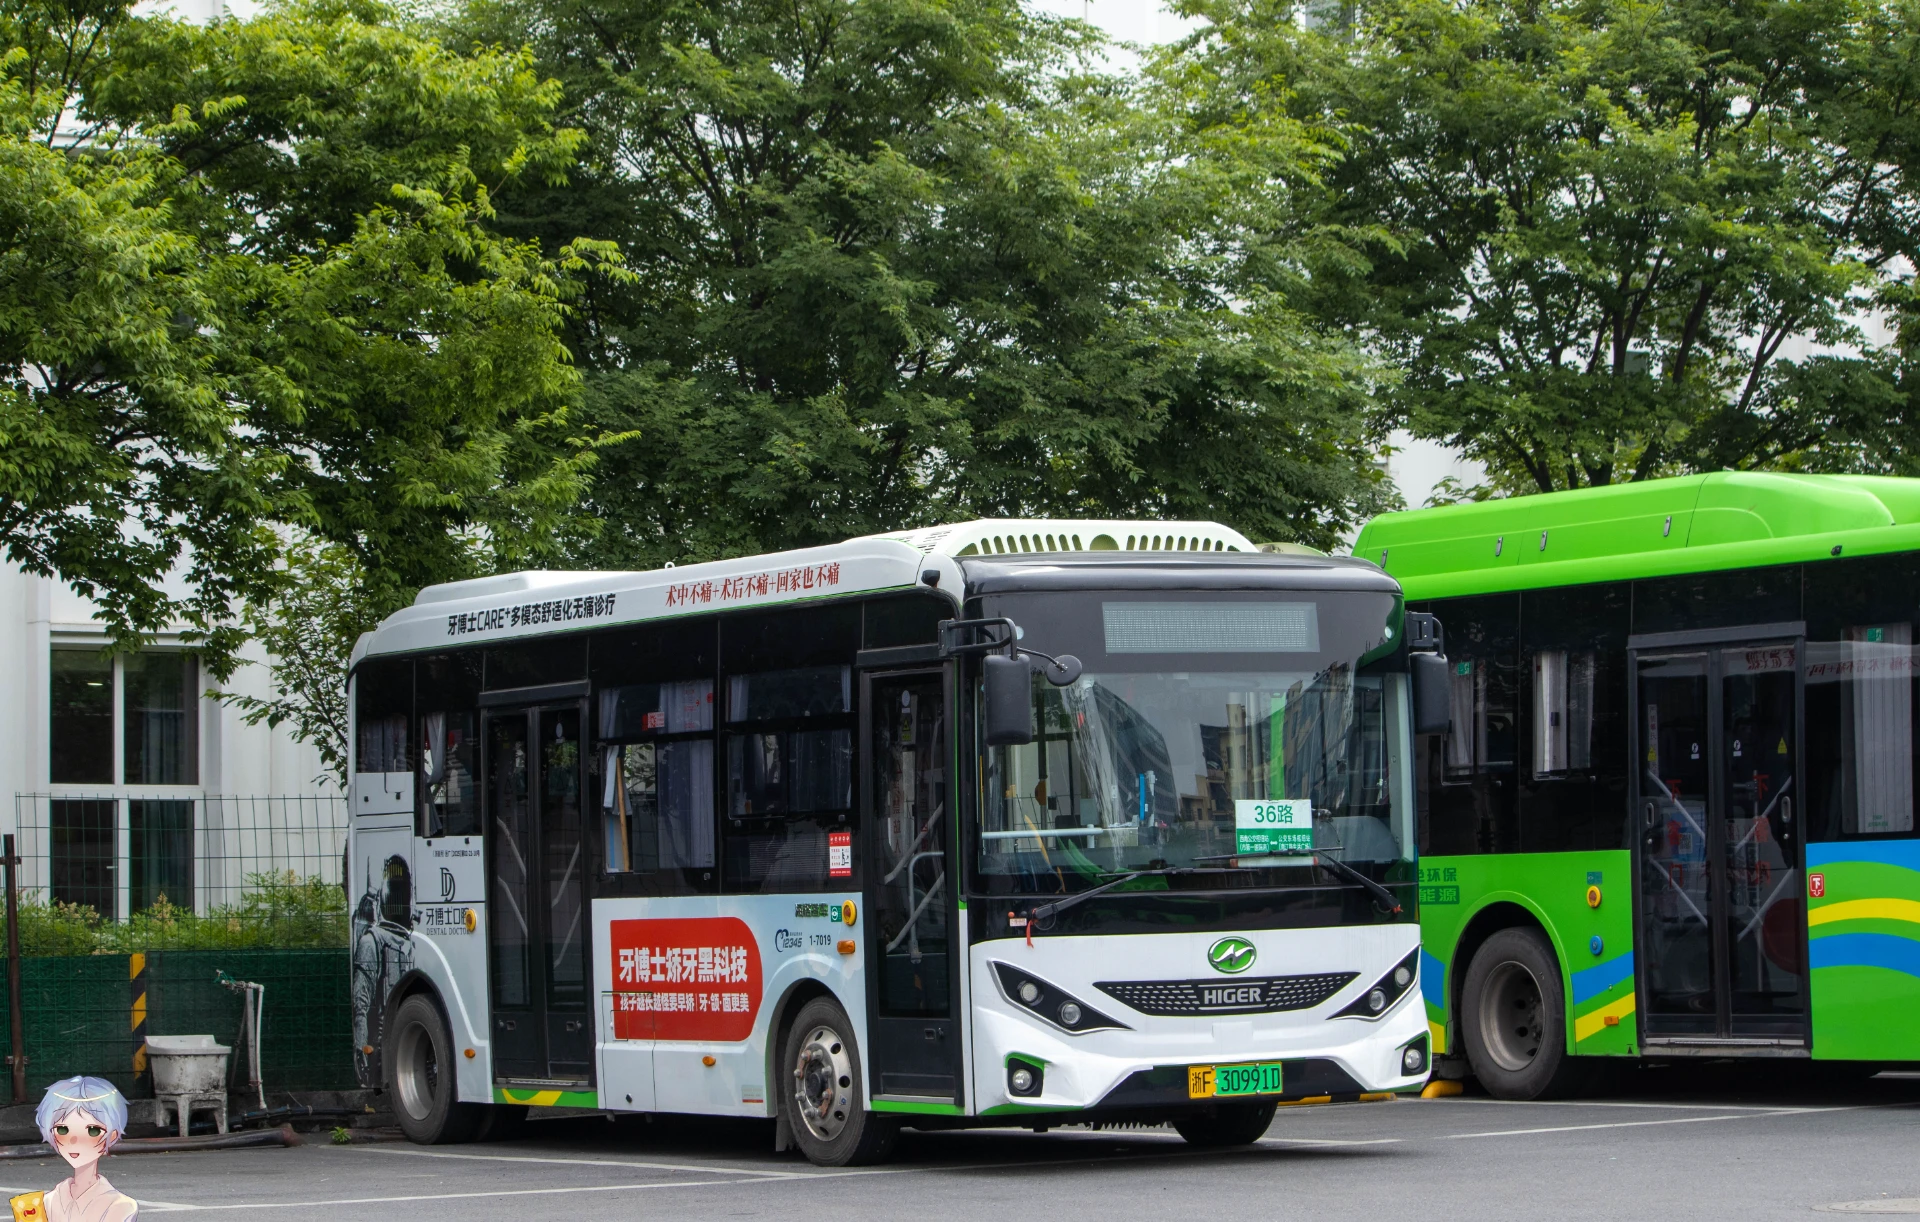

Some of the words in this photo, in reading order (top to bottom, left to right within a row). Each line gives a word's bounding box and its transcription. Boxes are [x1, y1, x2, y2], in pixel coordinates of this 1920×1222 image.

[665, 562, 840, 607] 术中不痛+术后不痛+回家也不痛
[1254, 804, 1293, 824] 36路
[1812, 877, 1821, 890] 下
[426, 927, 447, 936] DENTAL
[809, 934, 832, 946] 1-7019
[782, 937, 803, 948] 12345
[618, 945, 748, 983] 牙博士矫牙黑科技
[1204, 987, 1262, 1005] HIGER
[1220, 1067, 1281, 1092] 30991D
